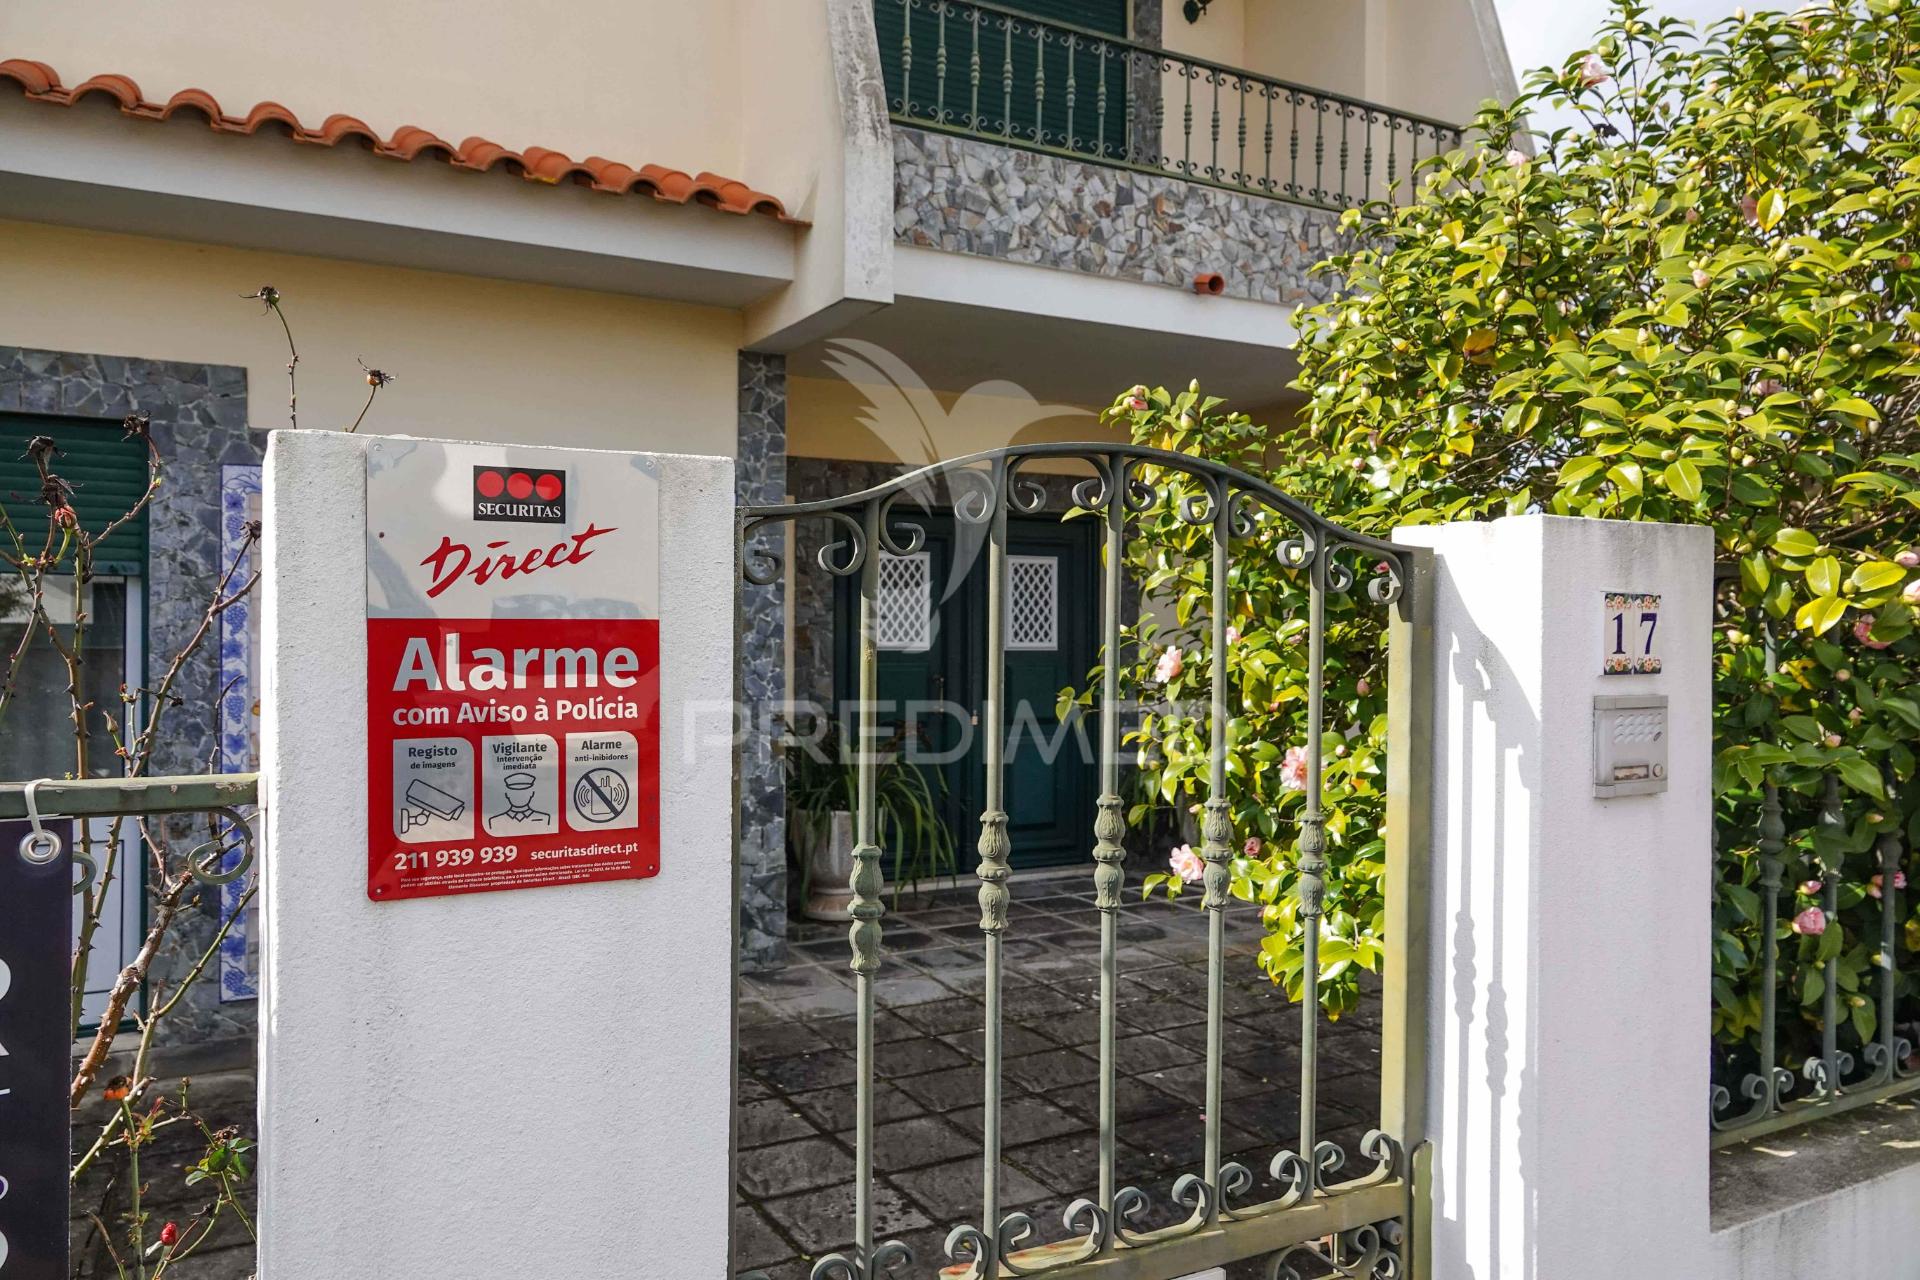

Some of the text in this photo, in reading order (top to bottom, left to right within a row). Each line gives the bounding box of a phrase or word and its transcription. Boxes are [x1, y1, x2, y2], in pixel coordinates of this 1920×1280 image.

[477, 502, 561, 519] SECURITAS
[420, 523, 619, 598] Direct
[1612, 613, 1657, 655] 17
[392, 633, 639, 691] Alarme
[393, 695, 639, 726] com Aviso à Polícia
[408, 745, 458, 759] Registo
[492, 742, 548, 756] Vigilante
[581, 739, 622, 751] Alarme
[410, 760, 456, 770] de imagens
[496, 754, 543, 763] Intervenção
[574, 753, 629, 762] anti-inibidores
[503, 762, 537, 771] imediata
[394, 845, 518, 871] 211 939 939
[530, 842, 638, 860] securitasdirect.pt
